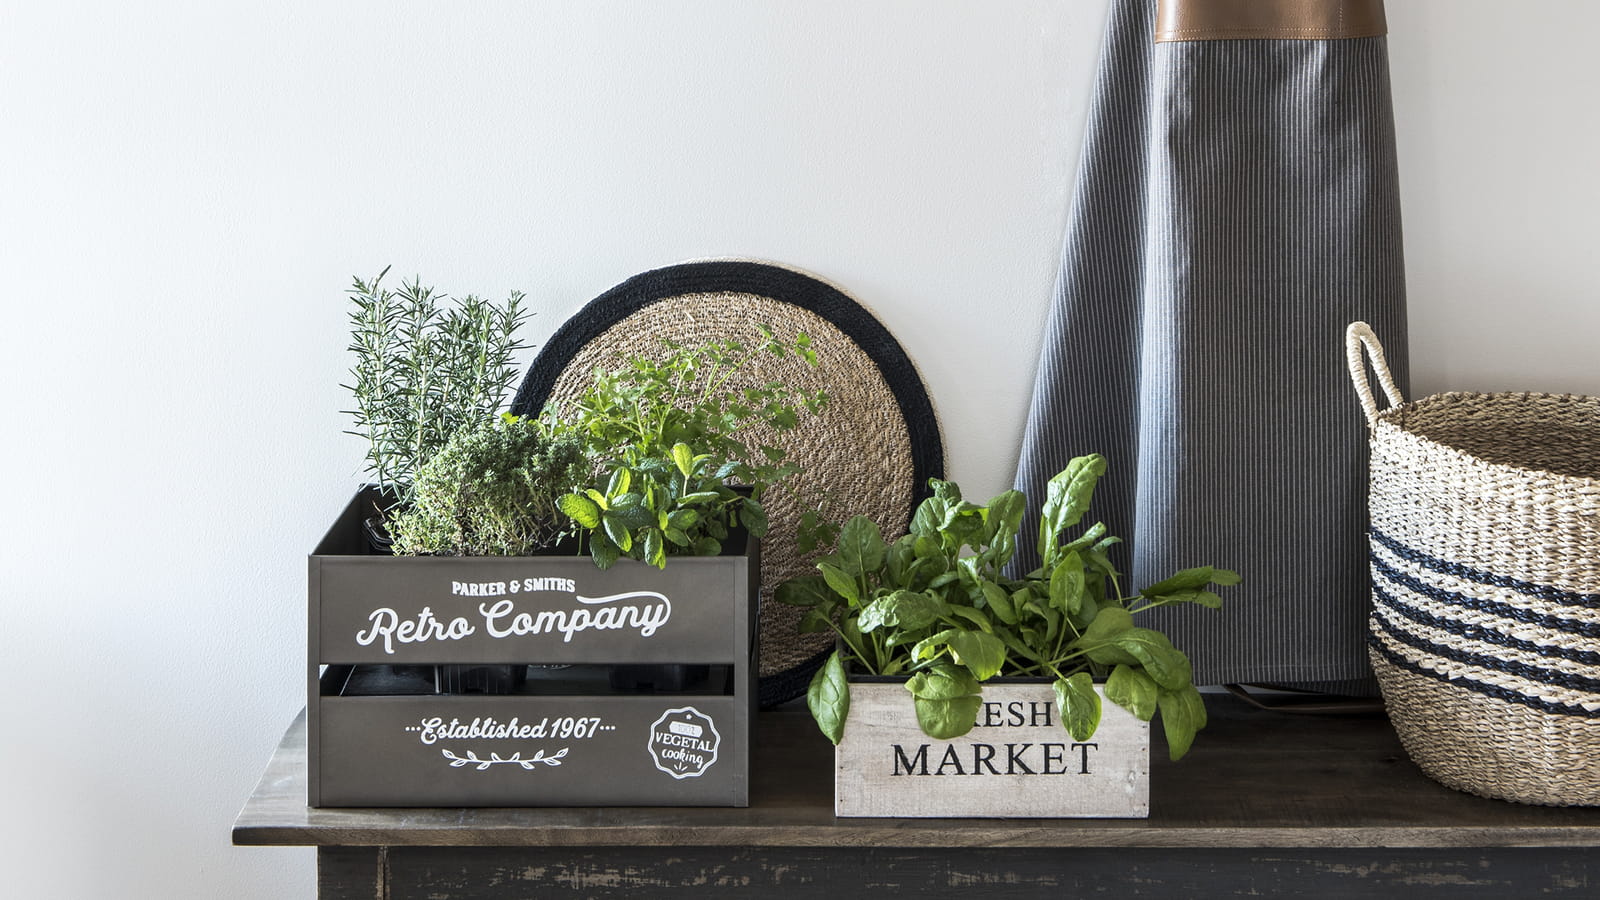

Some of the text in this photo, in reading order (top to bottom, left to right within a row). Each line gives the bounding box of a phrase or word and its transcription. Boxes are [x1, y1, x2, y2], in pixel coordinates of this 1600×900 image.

[452, 577, 576, 597] PARKER & SMITHS
[355, 590, 671, 654] Retro Company
[973, 701, 1054, 727] ESH
[420, 717, 602, 745] Established 1967
[655, 731, 714, 753] VEGETAL
[661, 748, 704, 769] cooking
[890, 743, 1099, 776] MARKET
